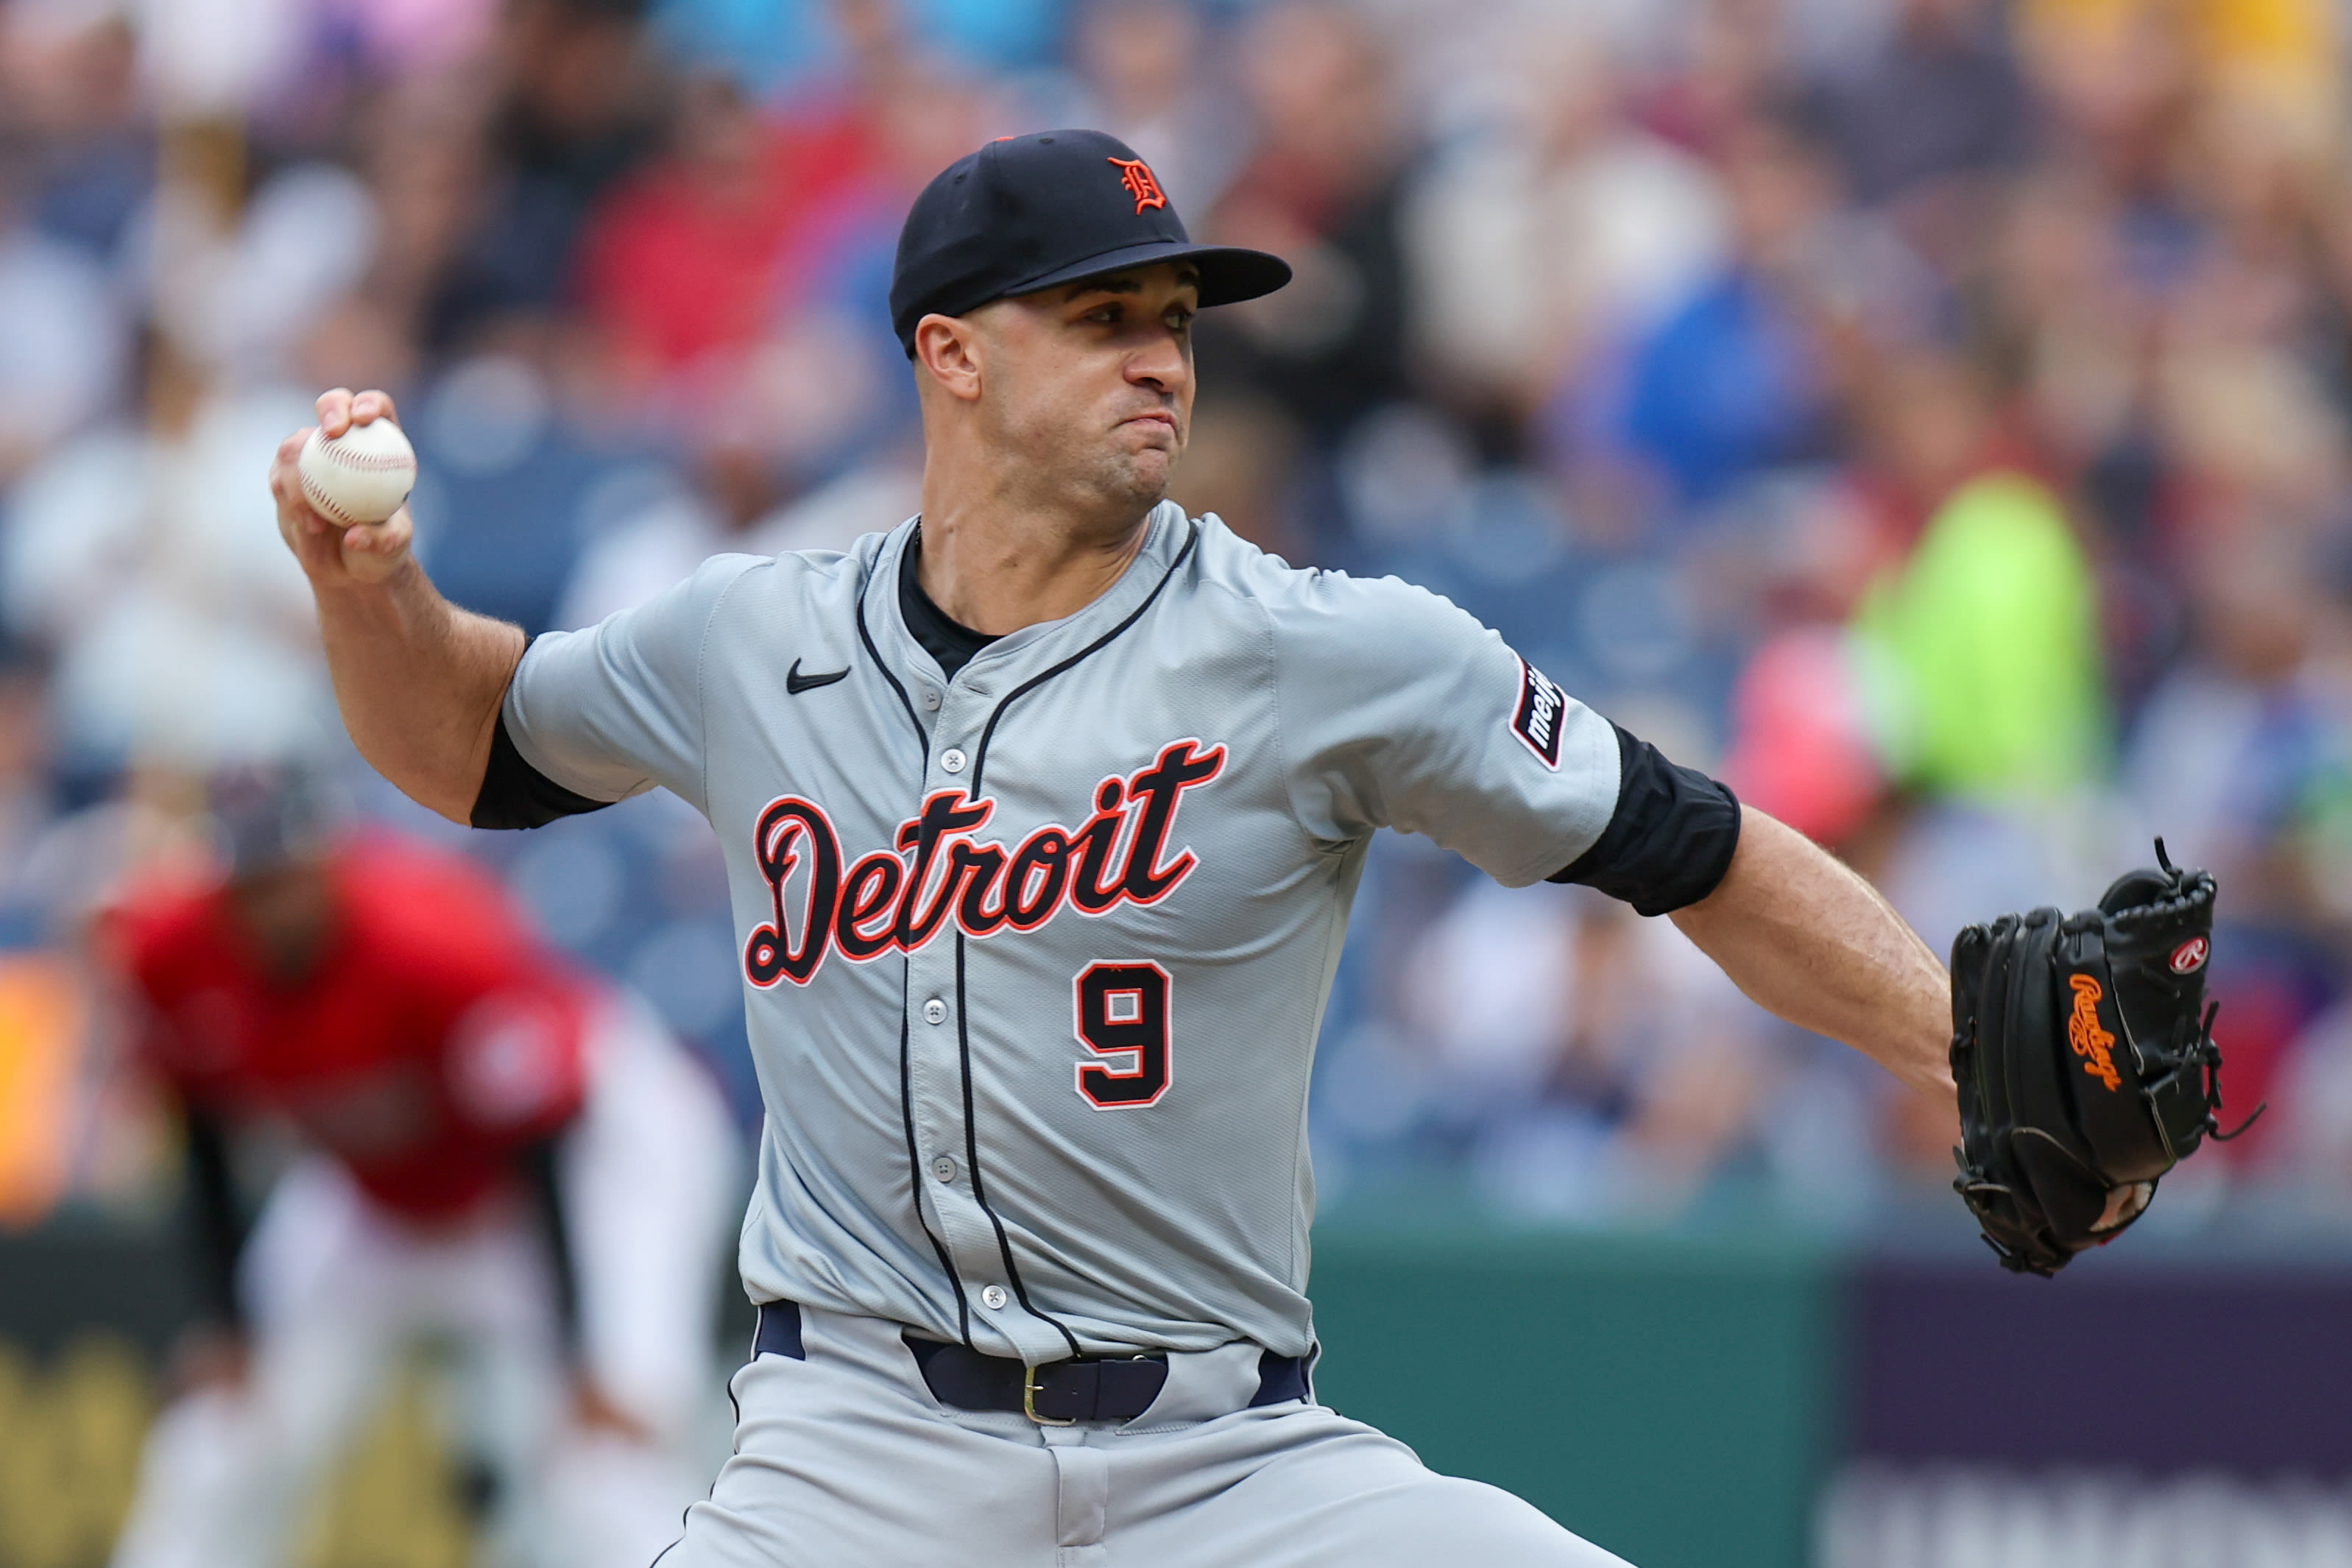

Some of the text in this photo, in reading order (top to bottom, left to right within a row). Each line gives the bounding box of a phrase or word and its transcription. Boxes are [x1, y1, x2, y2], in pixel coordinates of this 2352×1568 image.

[1106, 157, 1168, 216] D
[744, 738, 1229, 989] Detroit
[2174, 939, 2204, 970] R
[1072, 959, 1173, 1111] 9
